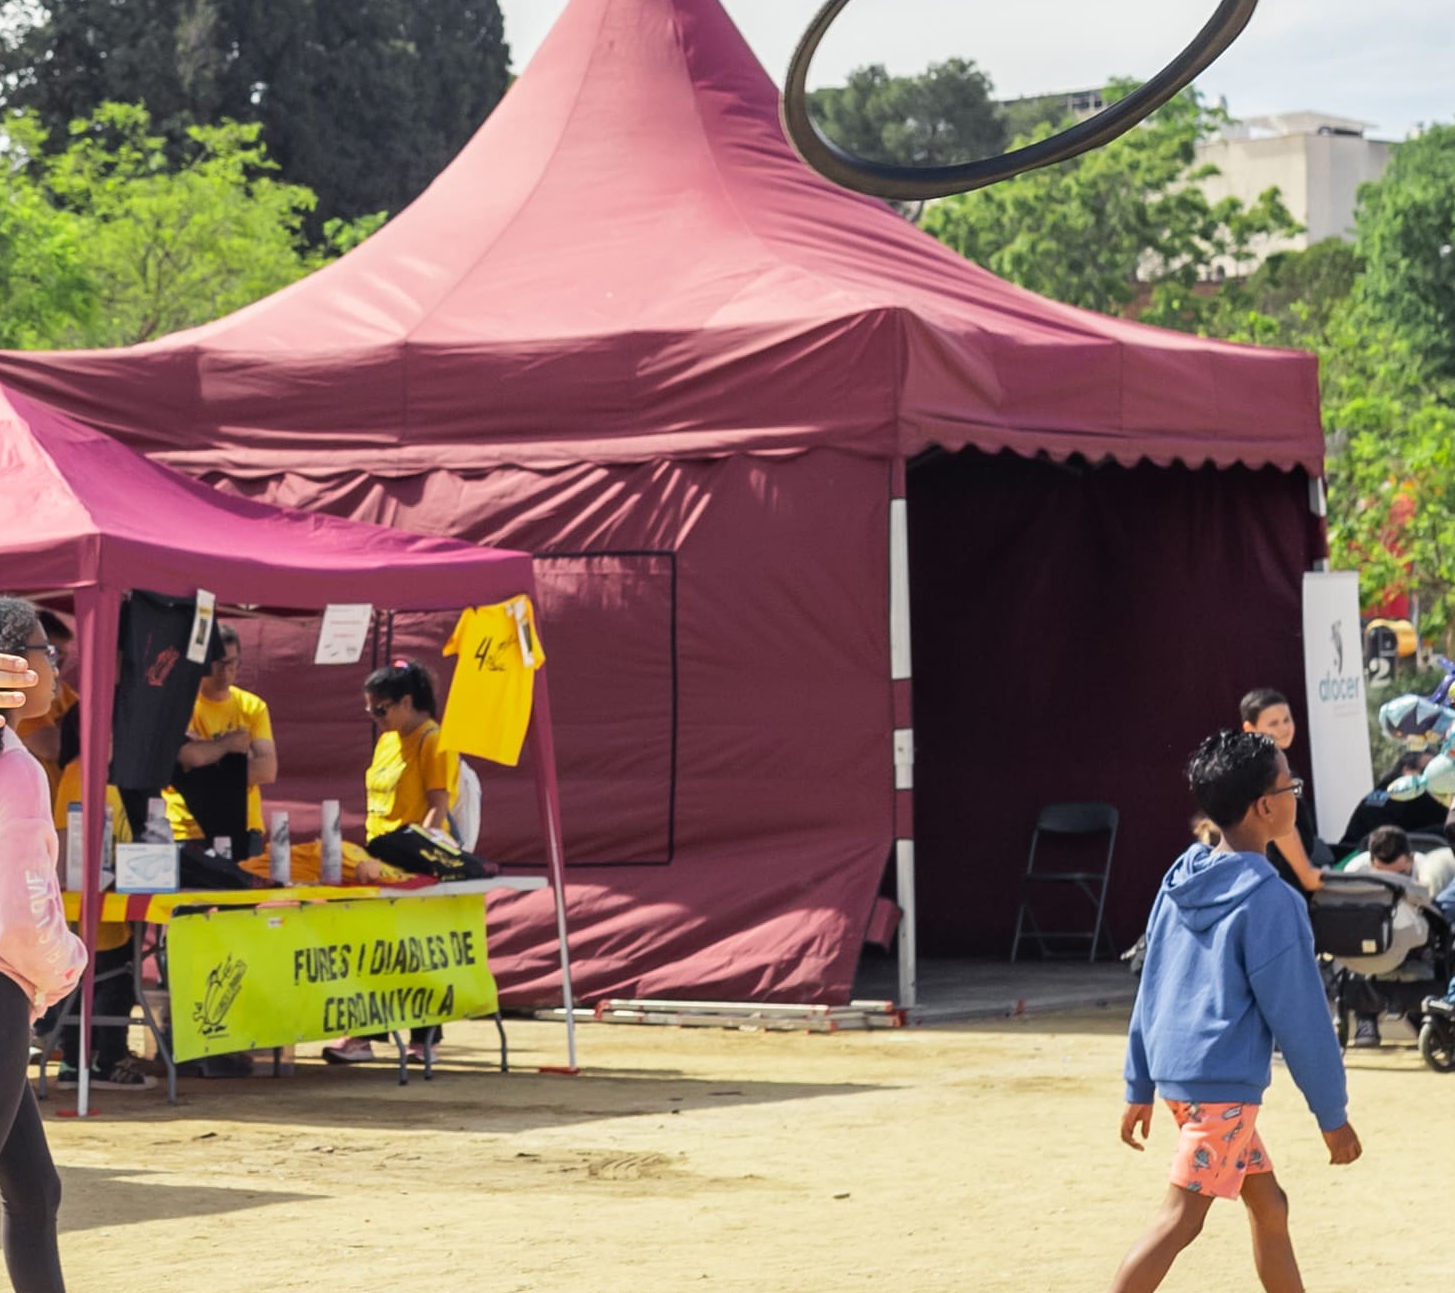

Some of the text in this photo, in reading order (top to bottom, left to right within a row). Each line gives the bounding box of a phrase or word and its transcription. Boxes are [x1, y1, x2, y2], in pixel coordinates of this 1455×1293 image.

[294, 944, 352, 985] FURES
[369, 935, 450, 975] DIABLES
[450, 930, 476, 966] DE
[322, 984, 455, 1033] CERDANYOLA
